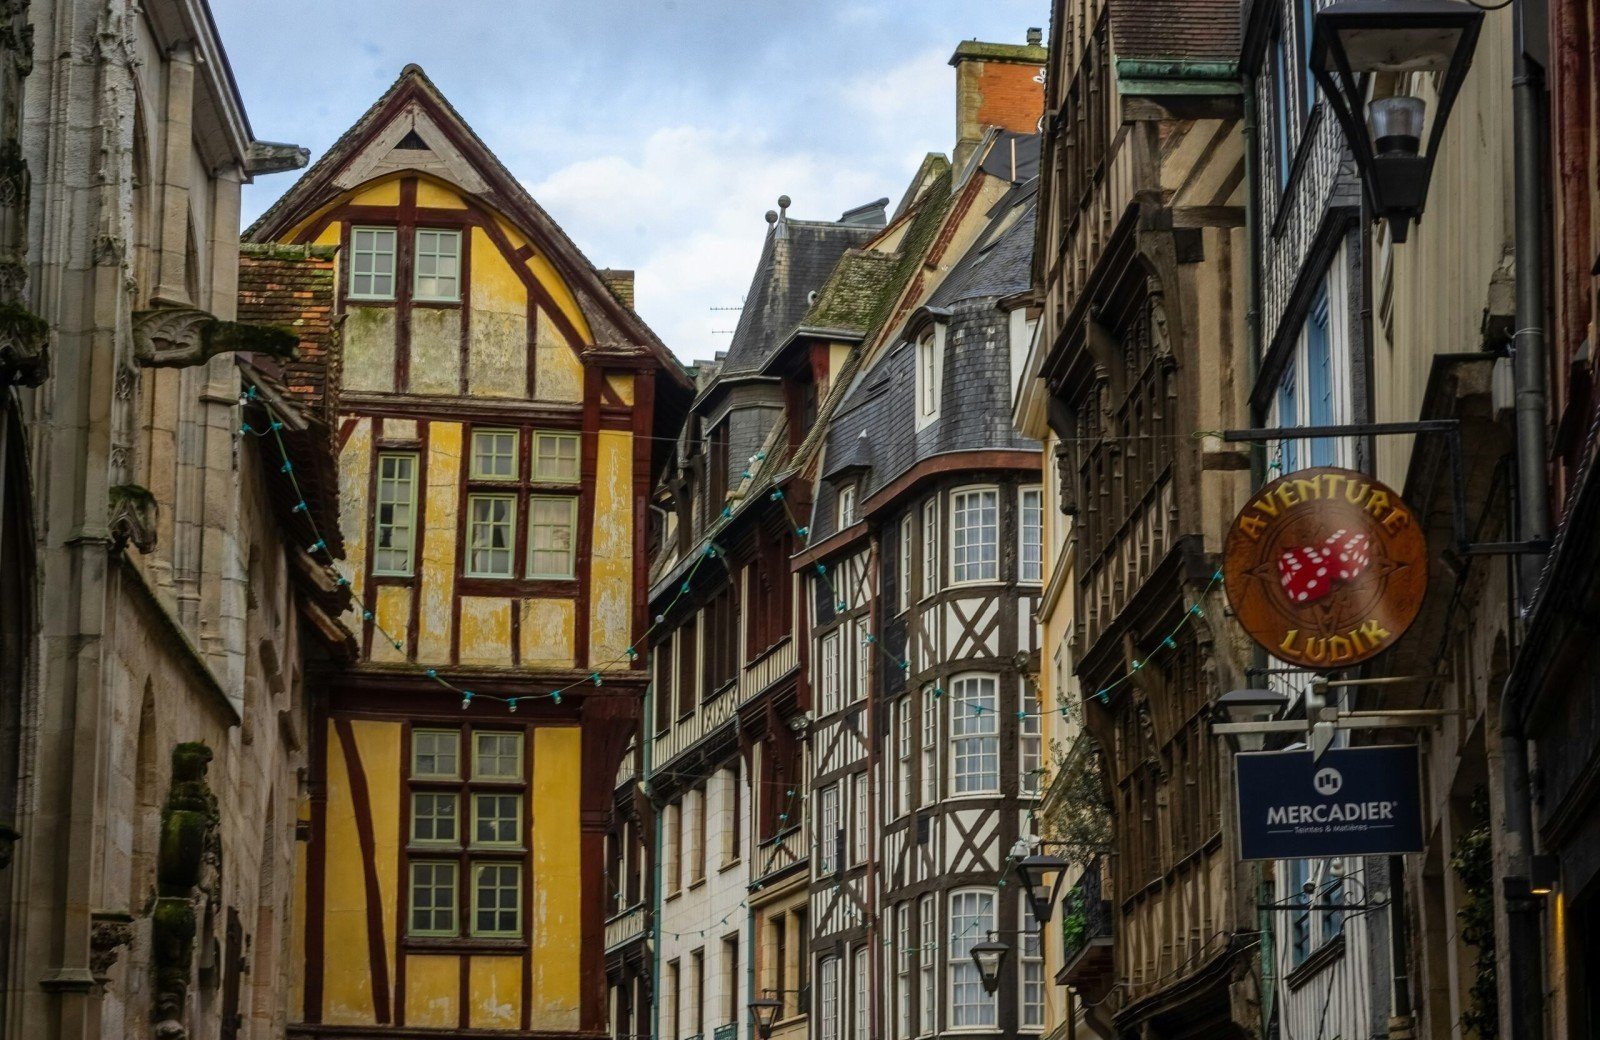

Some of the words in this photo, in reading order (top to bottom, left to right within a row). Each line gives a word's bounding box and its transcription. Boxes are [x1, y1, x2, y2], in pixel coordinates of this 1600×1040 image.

[1239, 474, 1409, 539] AVENTURE
[1280, 619, 1390, 662] LUDIK
[1267, 801, 1394, 825] MERCADIER
